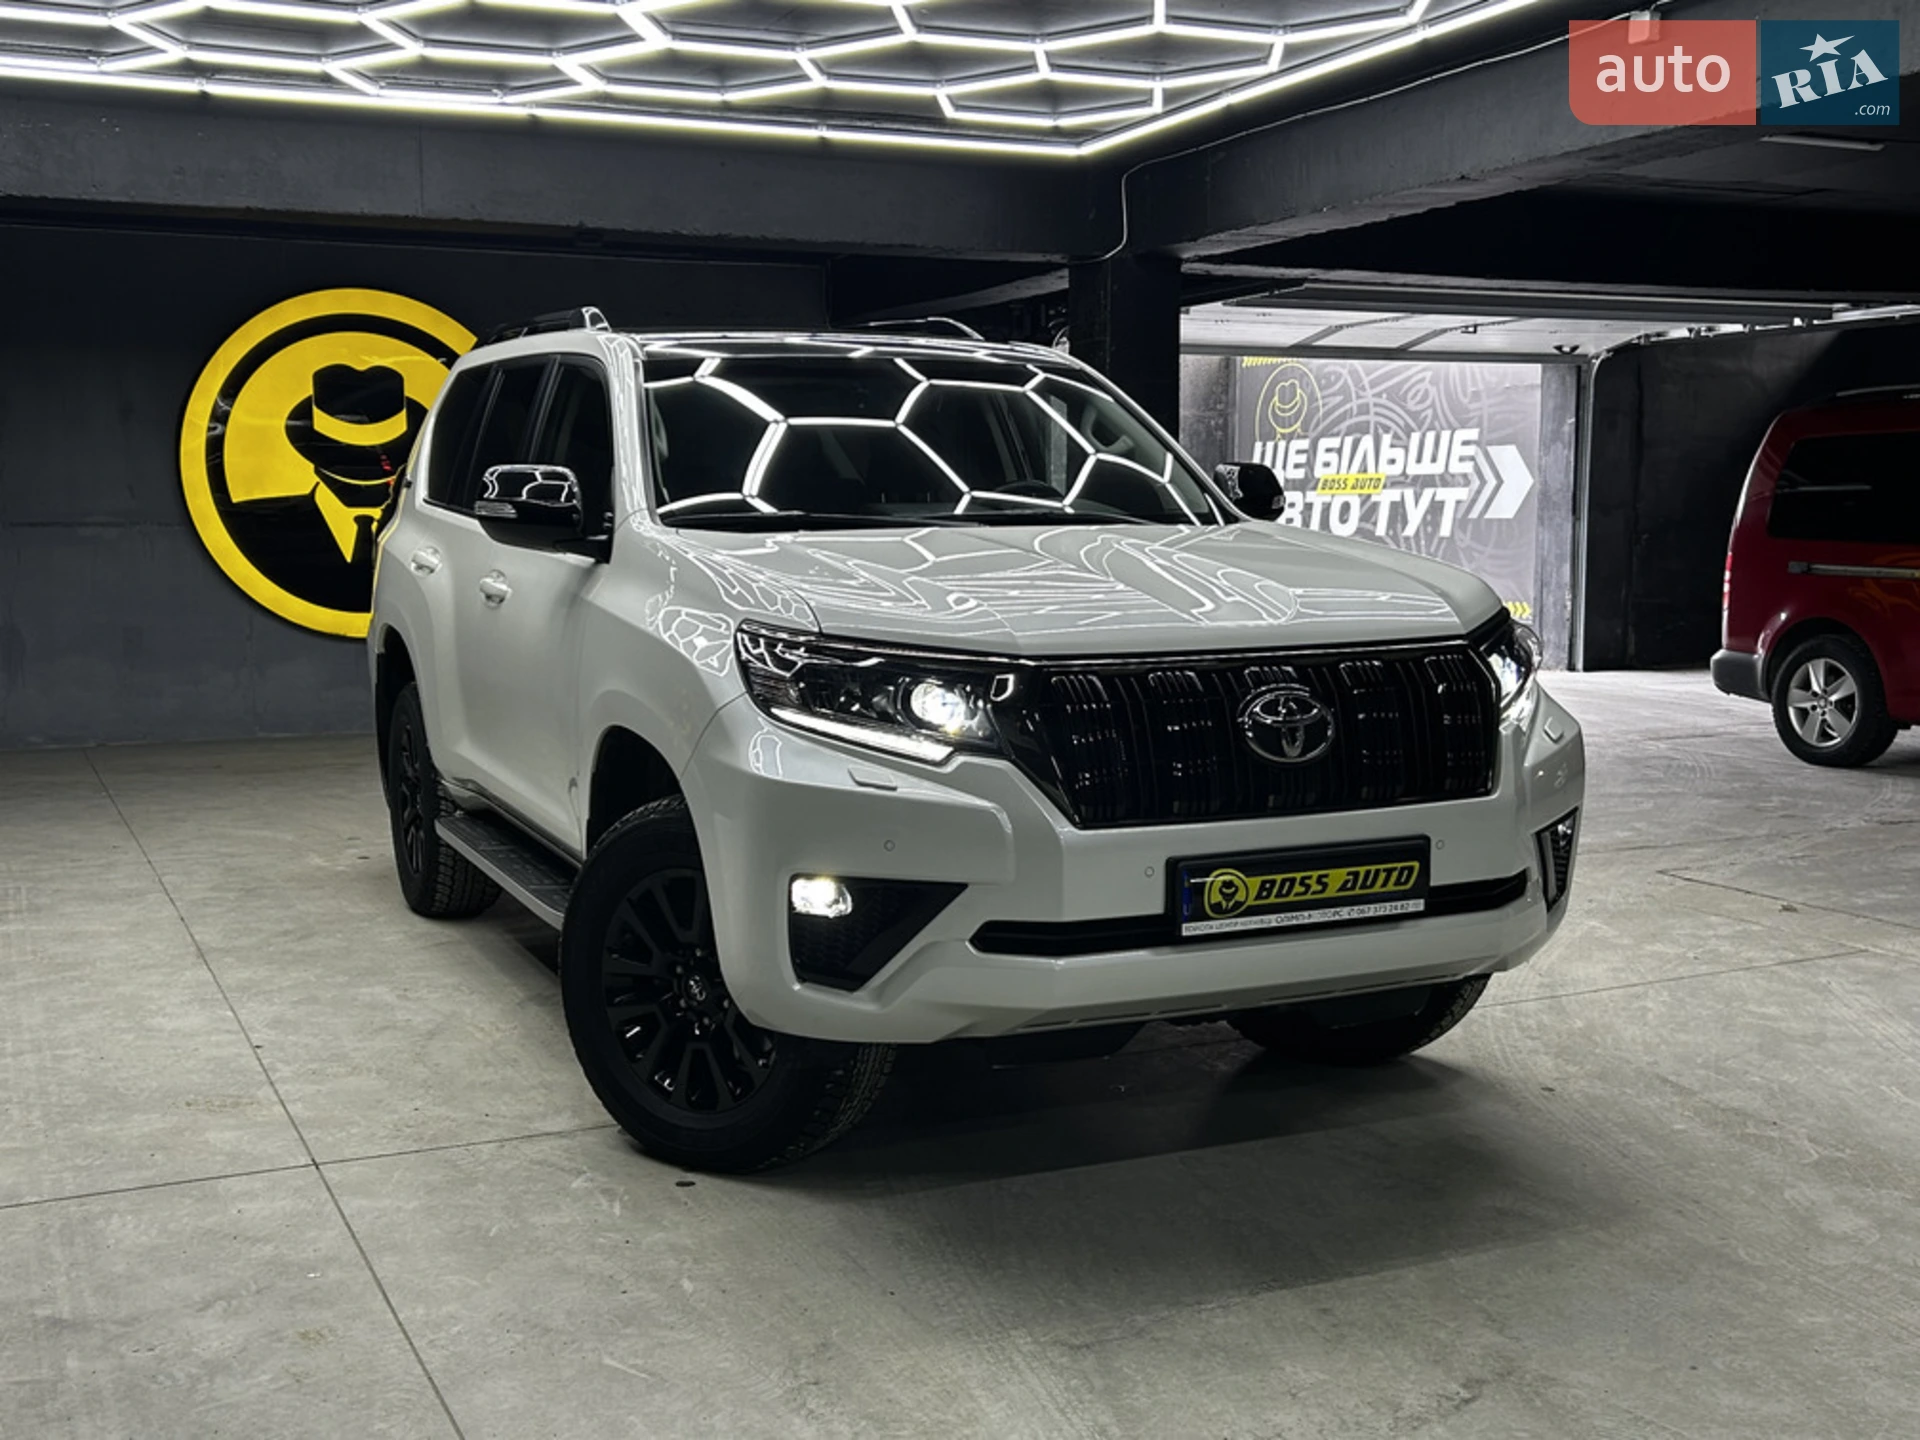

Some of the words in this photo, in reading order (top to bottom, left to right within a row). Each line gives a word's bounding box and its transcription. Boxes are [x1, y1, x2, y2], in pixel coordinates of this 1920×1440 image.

[1314, 428, 1480, 479] БІЛЬШЕ
[1320, 478, 1349, 491] BOSS
[1351, 476, 1382, 490] AUTO
[1277, 490, 1361, 537] ВТО
[1372, 487, 1469, 537] ТУТ
[1253, 871, 1329, 900] BOSS
[1335, 865, 1416, 894] AUTO
